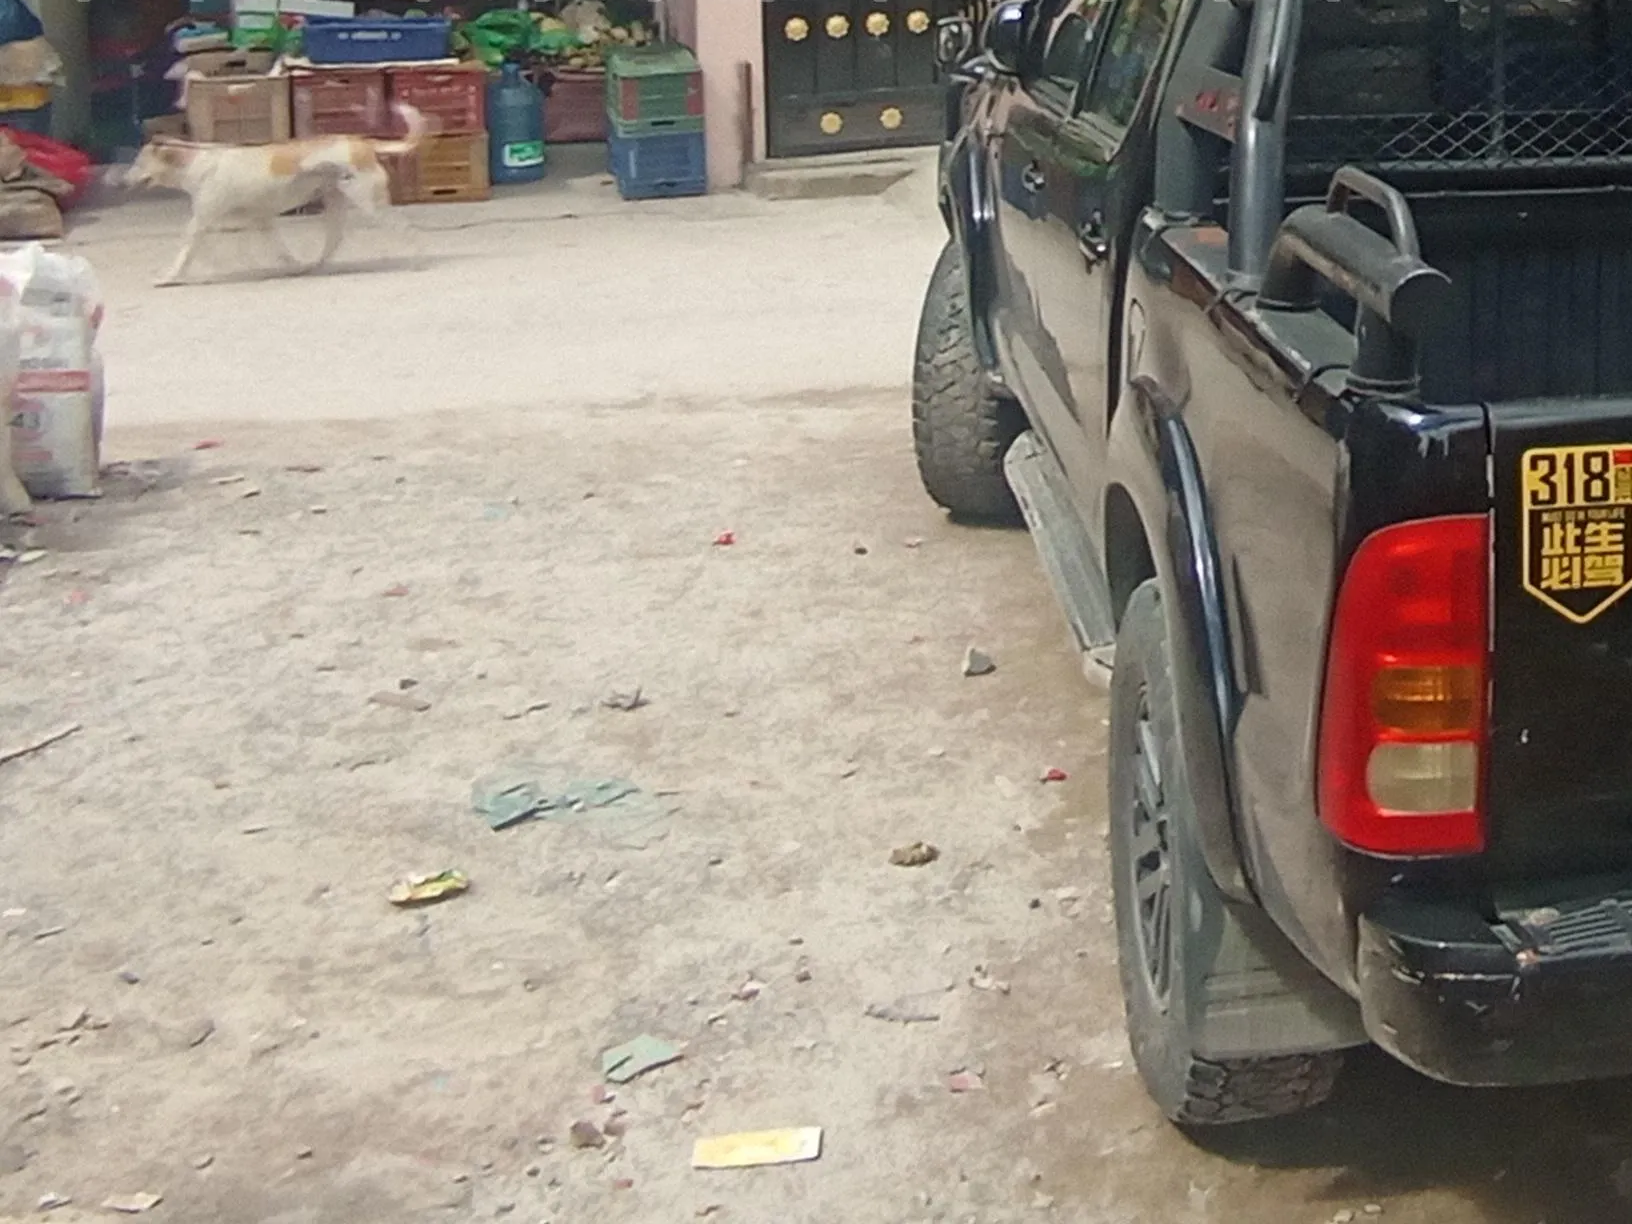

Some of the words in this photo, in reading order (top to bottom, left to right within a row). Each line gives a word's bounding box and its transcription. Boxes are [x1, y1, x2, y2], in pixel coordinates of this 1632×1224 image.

[1529, 451, 1611, 506] 318
[1541, 521, 1625, 554] 此生
[1540, 554, 1625, 590] 必驾
